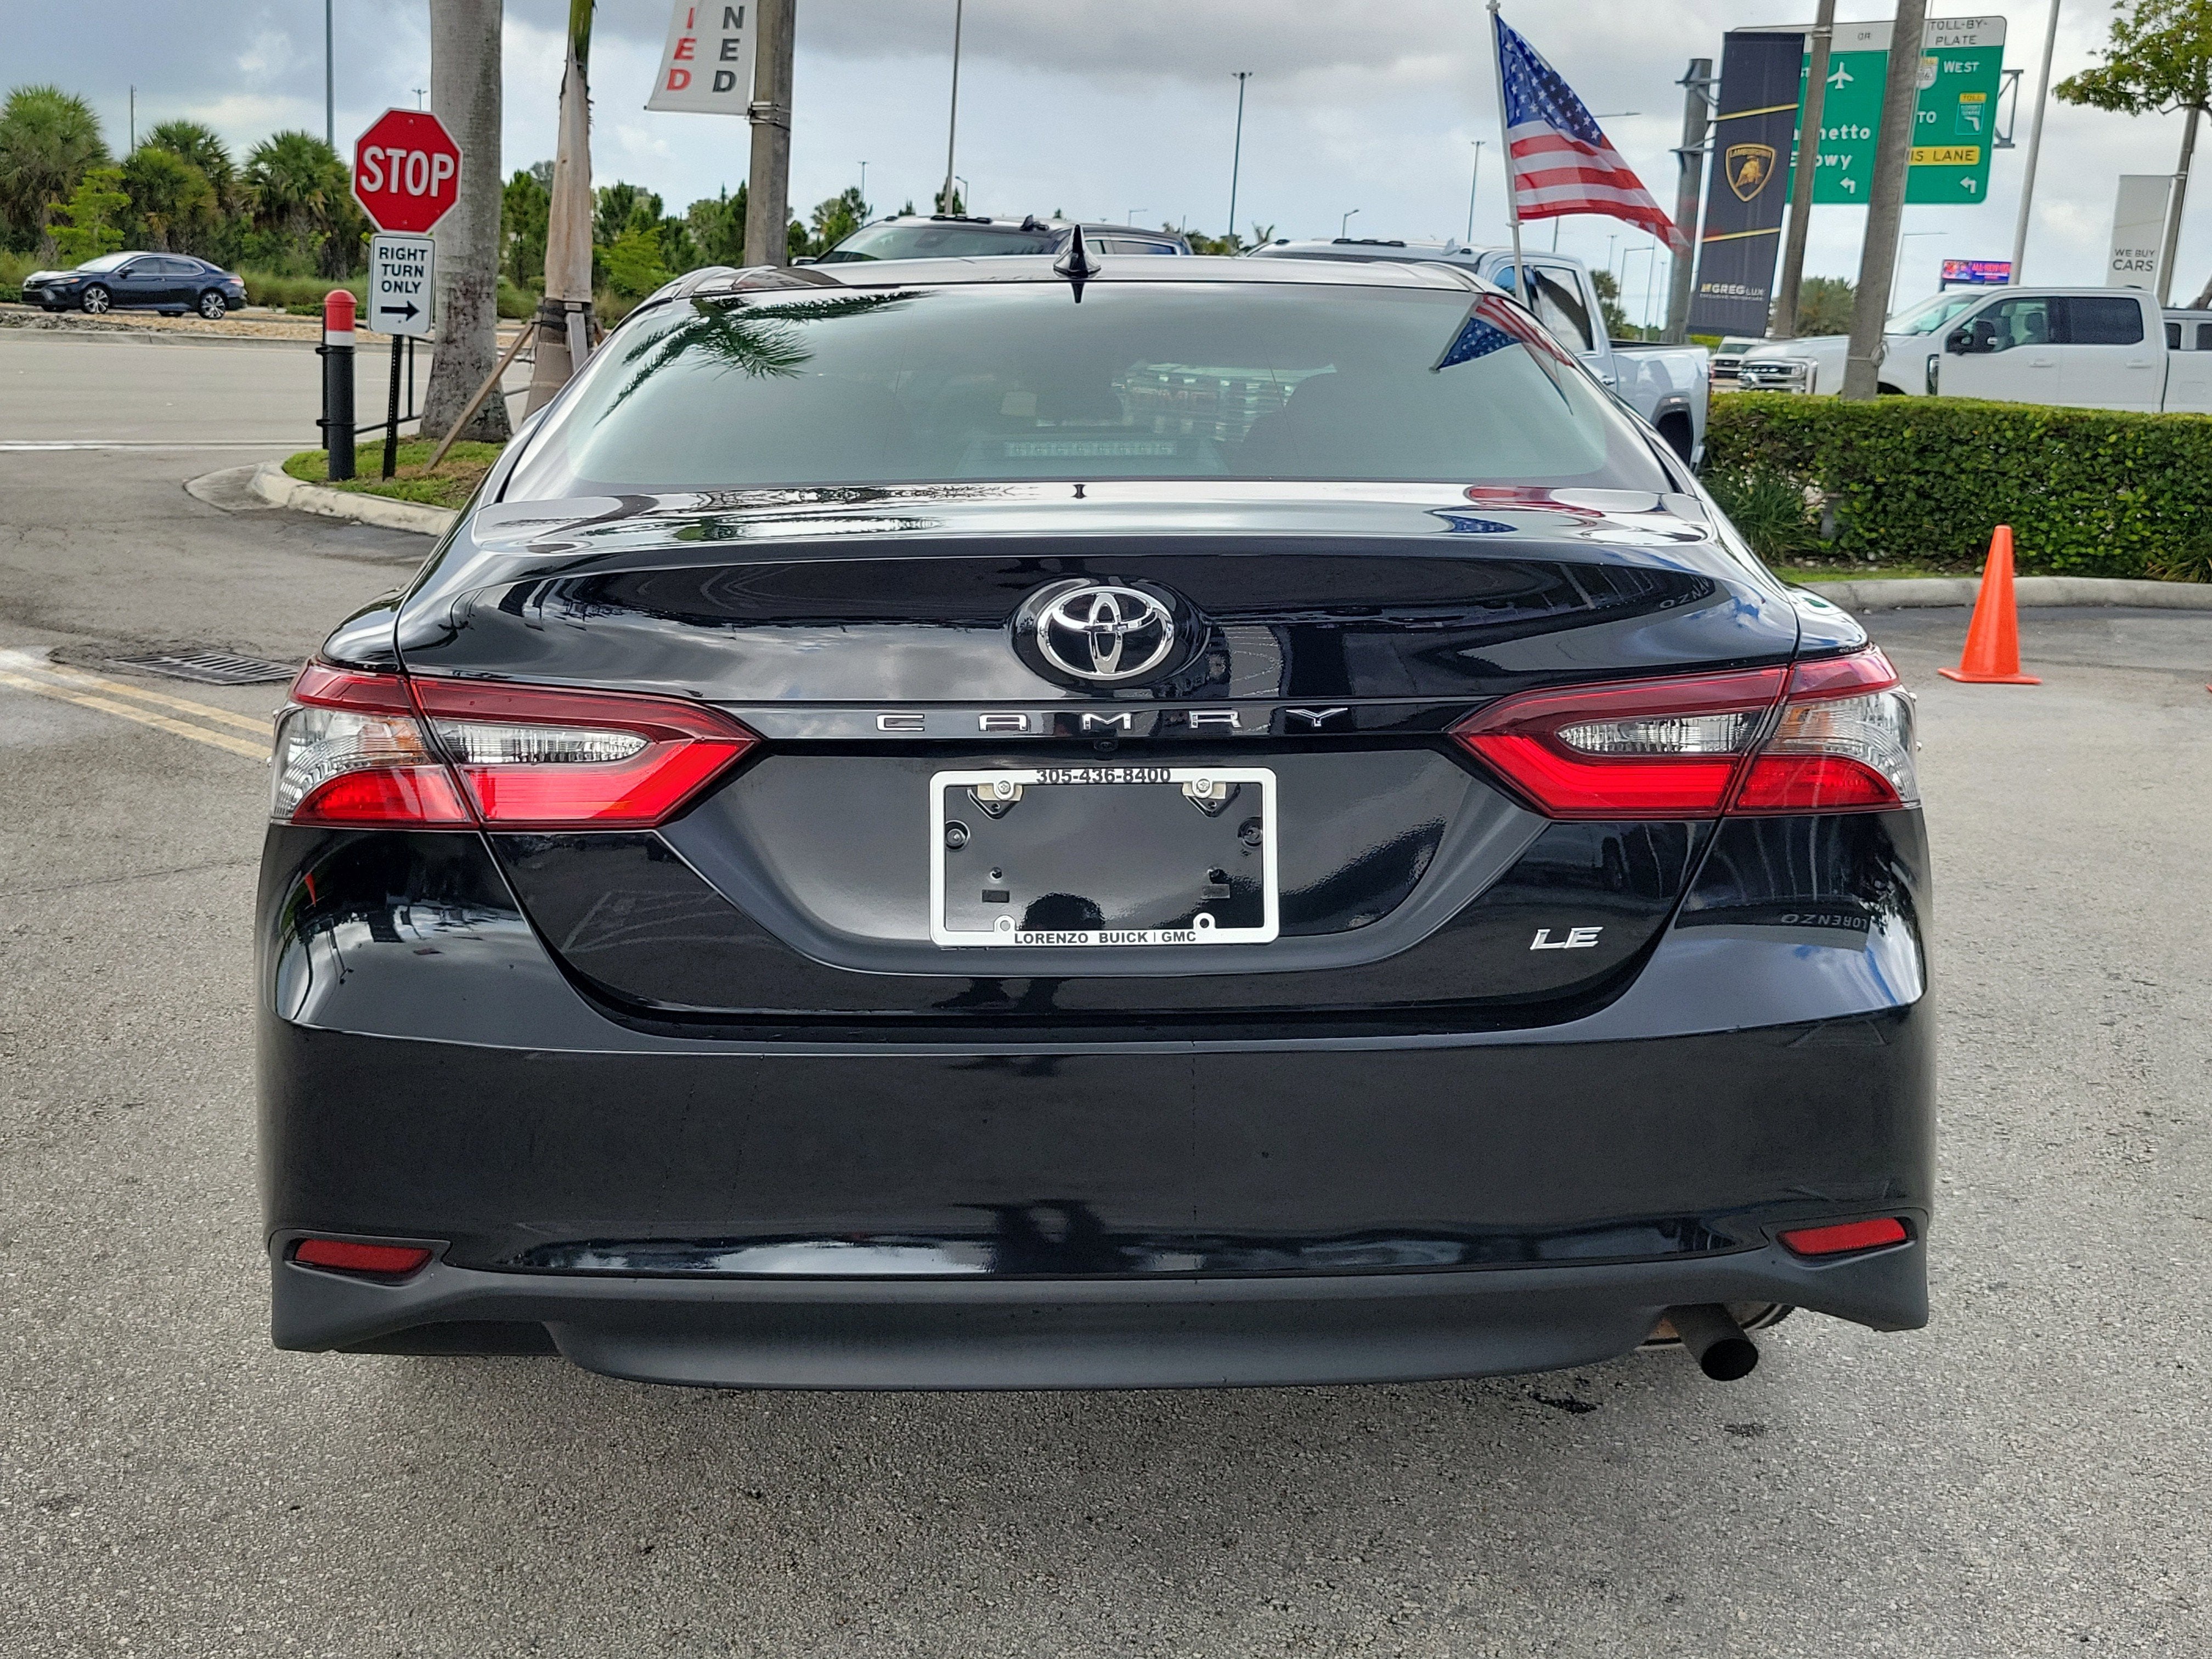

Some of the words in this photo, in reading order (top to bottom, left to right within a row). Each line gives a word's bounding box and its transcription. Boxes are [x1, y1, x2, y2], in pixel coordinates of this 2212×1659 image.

[1935, 35, 1977, 46] PLATE
[1943, 61, 1980, 73] WEST
[1917, 111, 1937, 123] TO
[1933, 150, 1975, 161] LANE
[360, 145, 454, 197] STOP
[380, 247, 428, 261] RIGHT
[2114, 249, 2132, 257] WE
[2135, 249, 2155, 257] BUY
[382, 264, 424, 278] TURN
[2113, 259, 2153, 272] CARS
[382, 280, 421, 294] ONLY
[877, 707, 1348, 731] CAMRY
[1036, 768, 1171, 784] 305-436-8400
[1014, 933, 1088, 944] LORENZO
[1099, 932, 1148, 944] BUICK
[1161, 931, 1197, 943] GMC
[1530, 926, 1604, 950] LE
